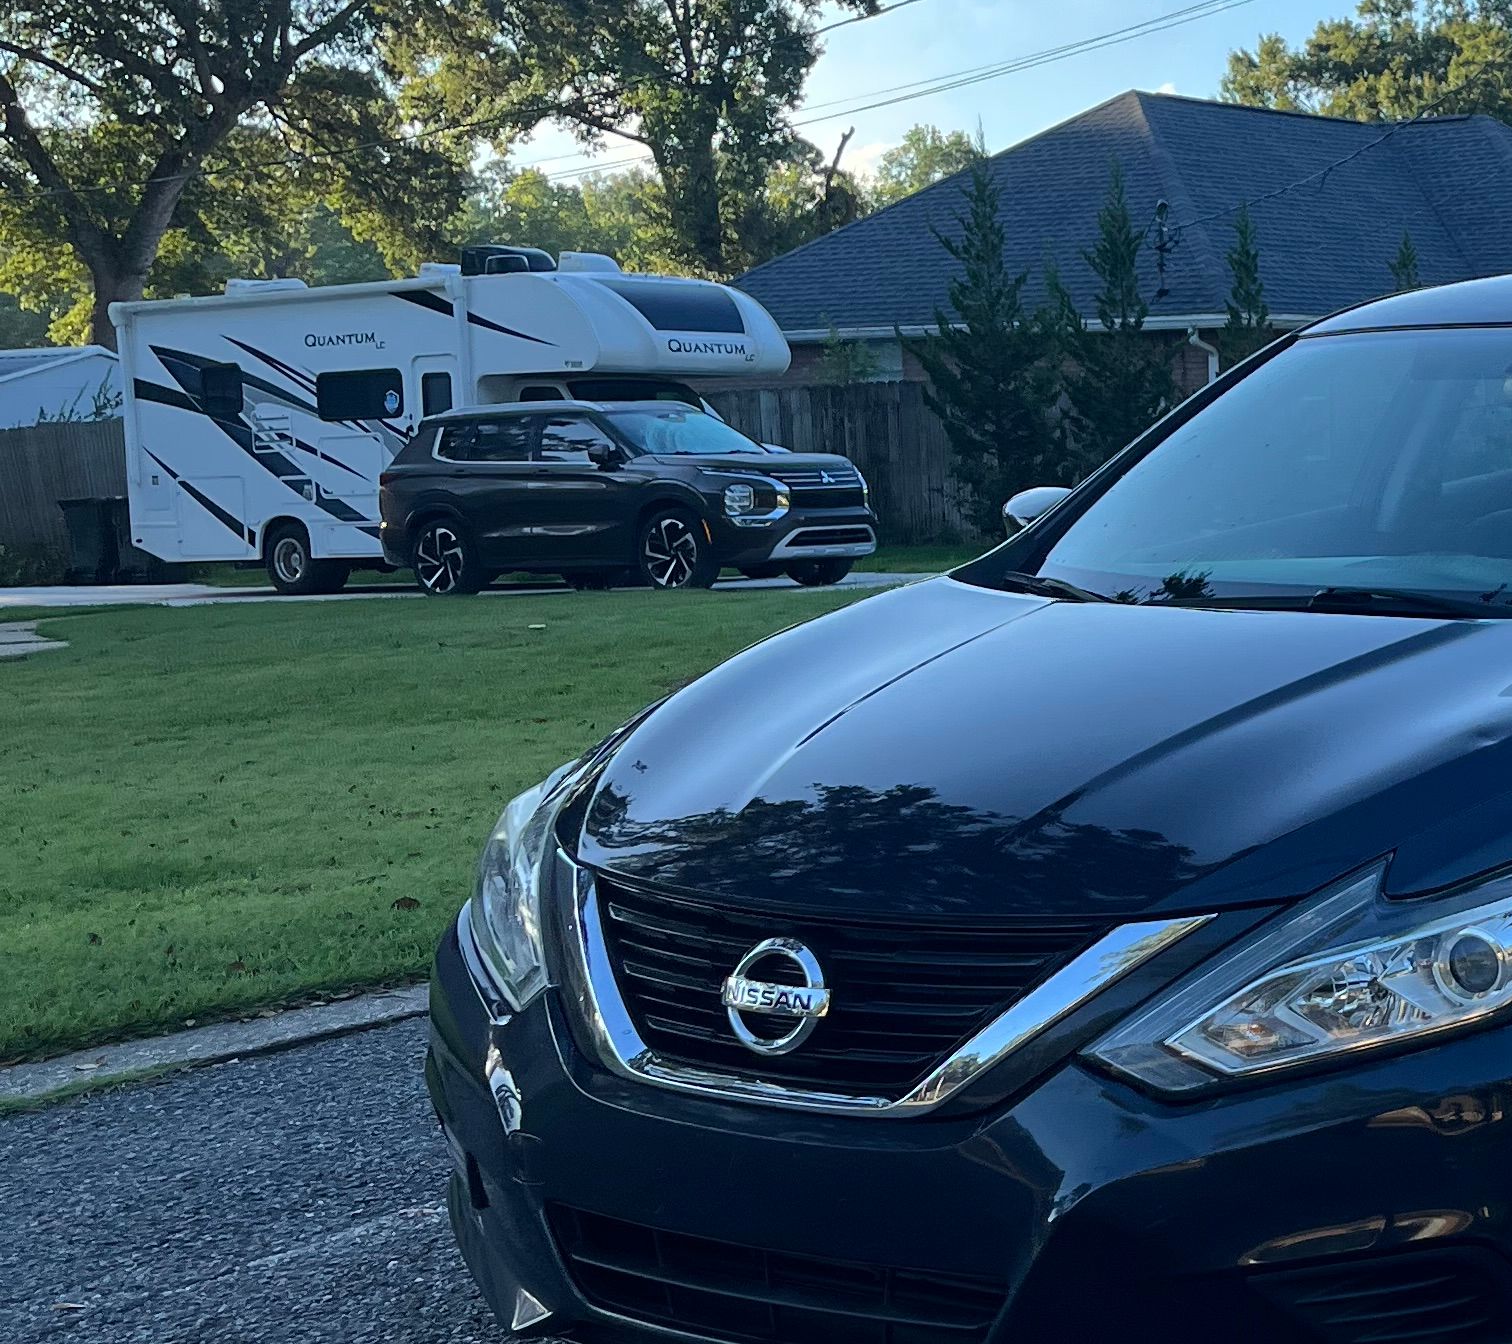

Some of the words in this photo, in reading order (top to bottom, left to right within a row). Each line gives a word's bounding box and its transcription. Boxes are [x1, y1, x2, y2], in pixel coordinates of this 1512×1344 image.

[304, 332, 375, 347] QUANTUM
[668, 339, 746, 354] QUANTUM
[725, 981, 812, 1010] NISSAN
